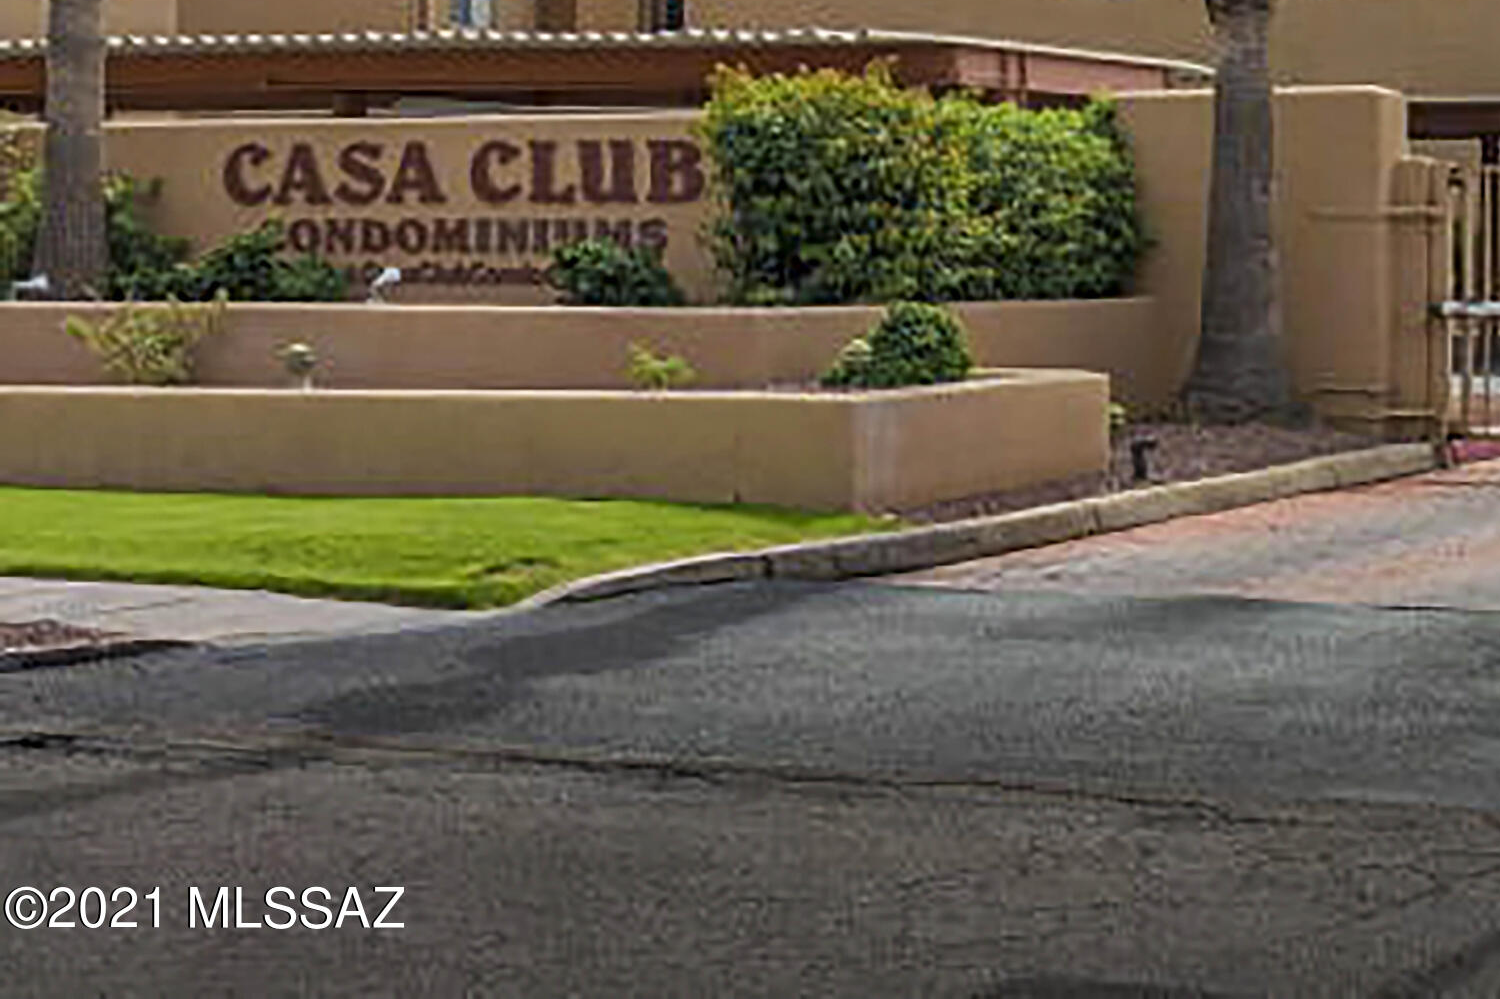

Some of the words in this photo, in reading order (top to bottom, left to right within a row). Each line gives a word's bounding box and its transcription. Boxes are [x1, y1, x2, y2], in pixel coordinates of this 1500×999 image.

[223, 140, 447, 206] CASA
[470, 137, 706, 206] CLUB
[262, 216, 668, 254] ONDOMINIUMS
